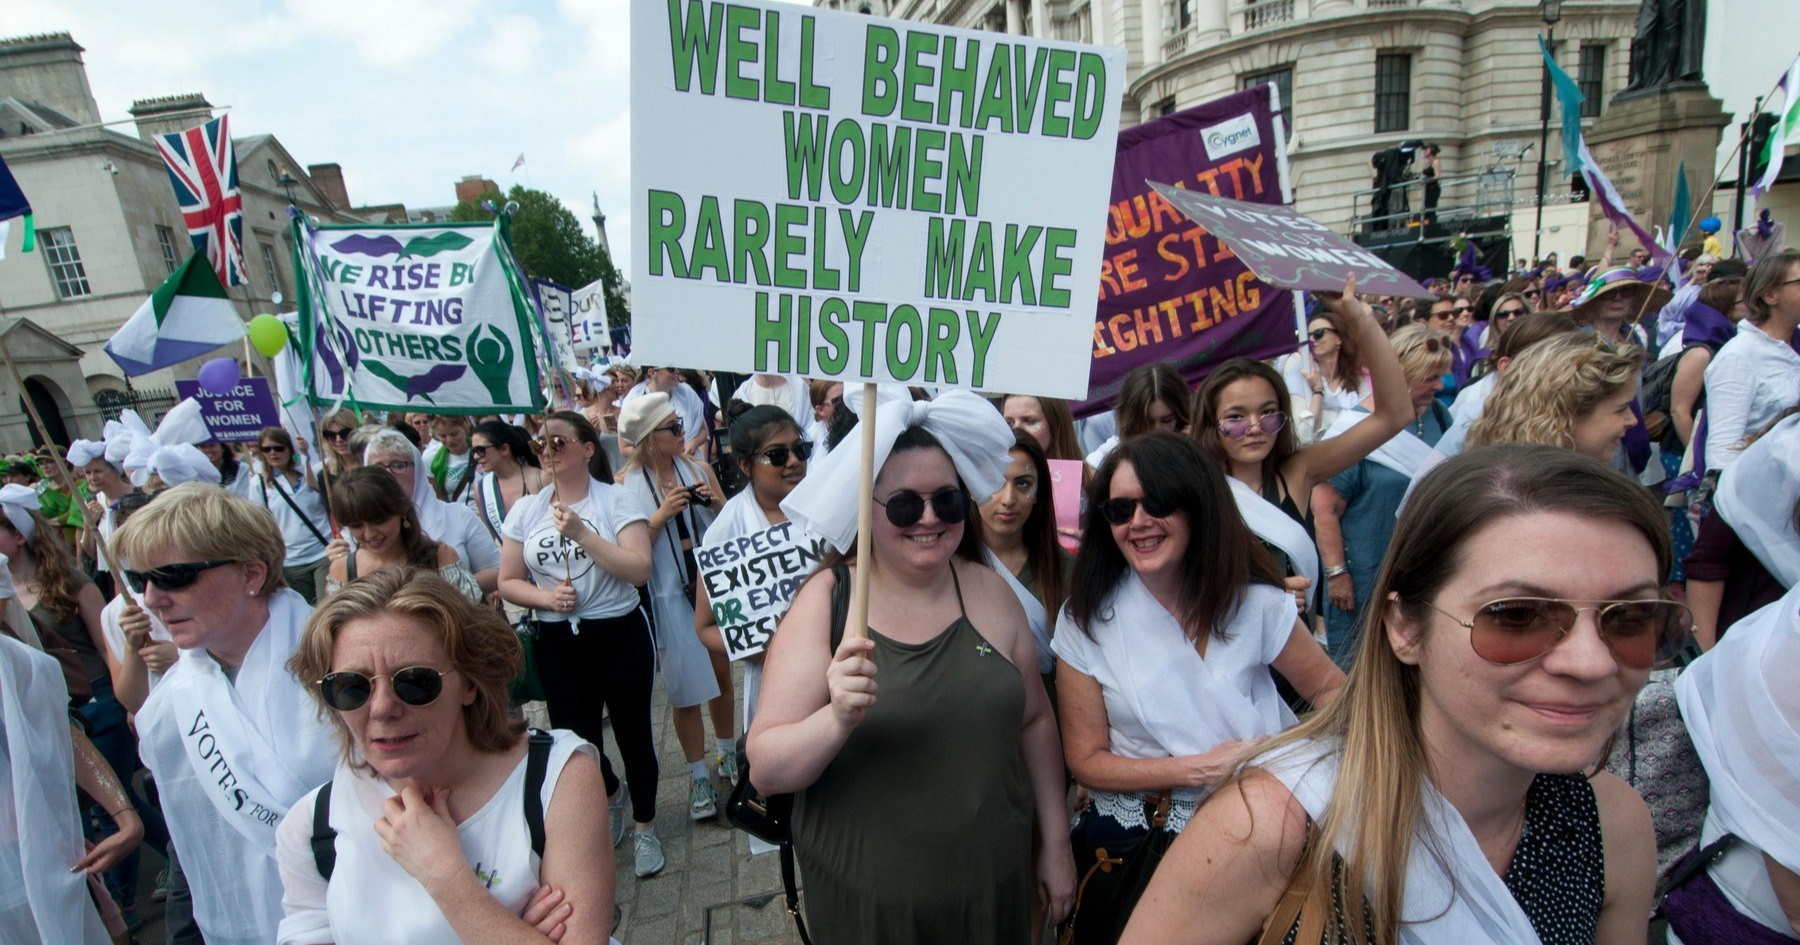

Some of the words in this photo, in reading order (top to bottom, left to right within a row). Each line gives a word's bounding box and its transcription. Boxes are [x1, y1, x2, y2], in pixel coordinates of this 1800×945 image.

[668, 0, 830, 110] WELL
[861, 24, 1107, 140] BEHAVED
[1209, 126, 1252, 147] Cygnet
[782, 111, 984, 217] WOMEN
[1104, 153, 1264, 245] QUAITY
[1195, 201, 1331, 232] VOTES
[648, 188, 875, 293] RARELY
[924, 216, 1077, 308] MAKE
[1240, 237, 1395, 271] WOMEN
[320, 254, 364, 285] WE
[366, 262, 441, 291] RISE
[449, 257, 480, 288] BY
[340, 290, 464, 327] LIFTING
[354, 326, 463, 362] OTHERS
[753, 291, 1002, 388] HISTORY
[196, 385, 256, 398] JUICE
[213, 400, 246, 412] FOR
[205, 413, 263, 427] WOMEN
[536, 545, 587, 567] PWR
[697, 521, 793, 571] RESPECT
[712, 597, 749, 627] OR
[188, 708, 250, 812] VOTES
[250, 803, 279, 828] FOR
